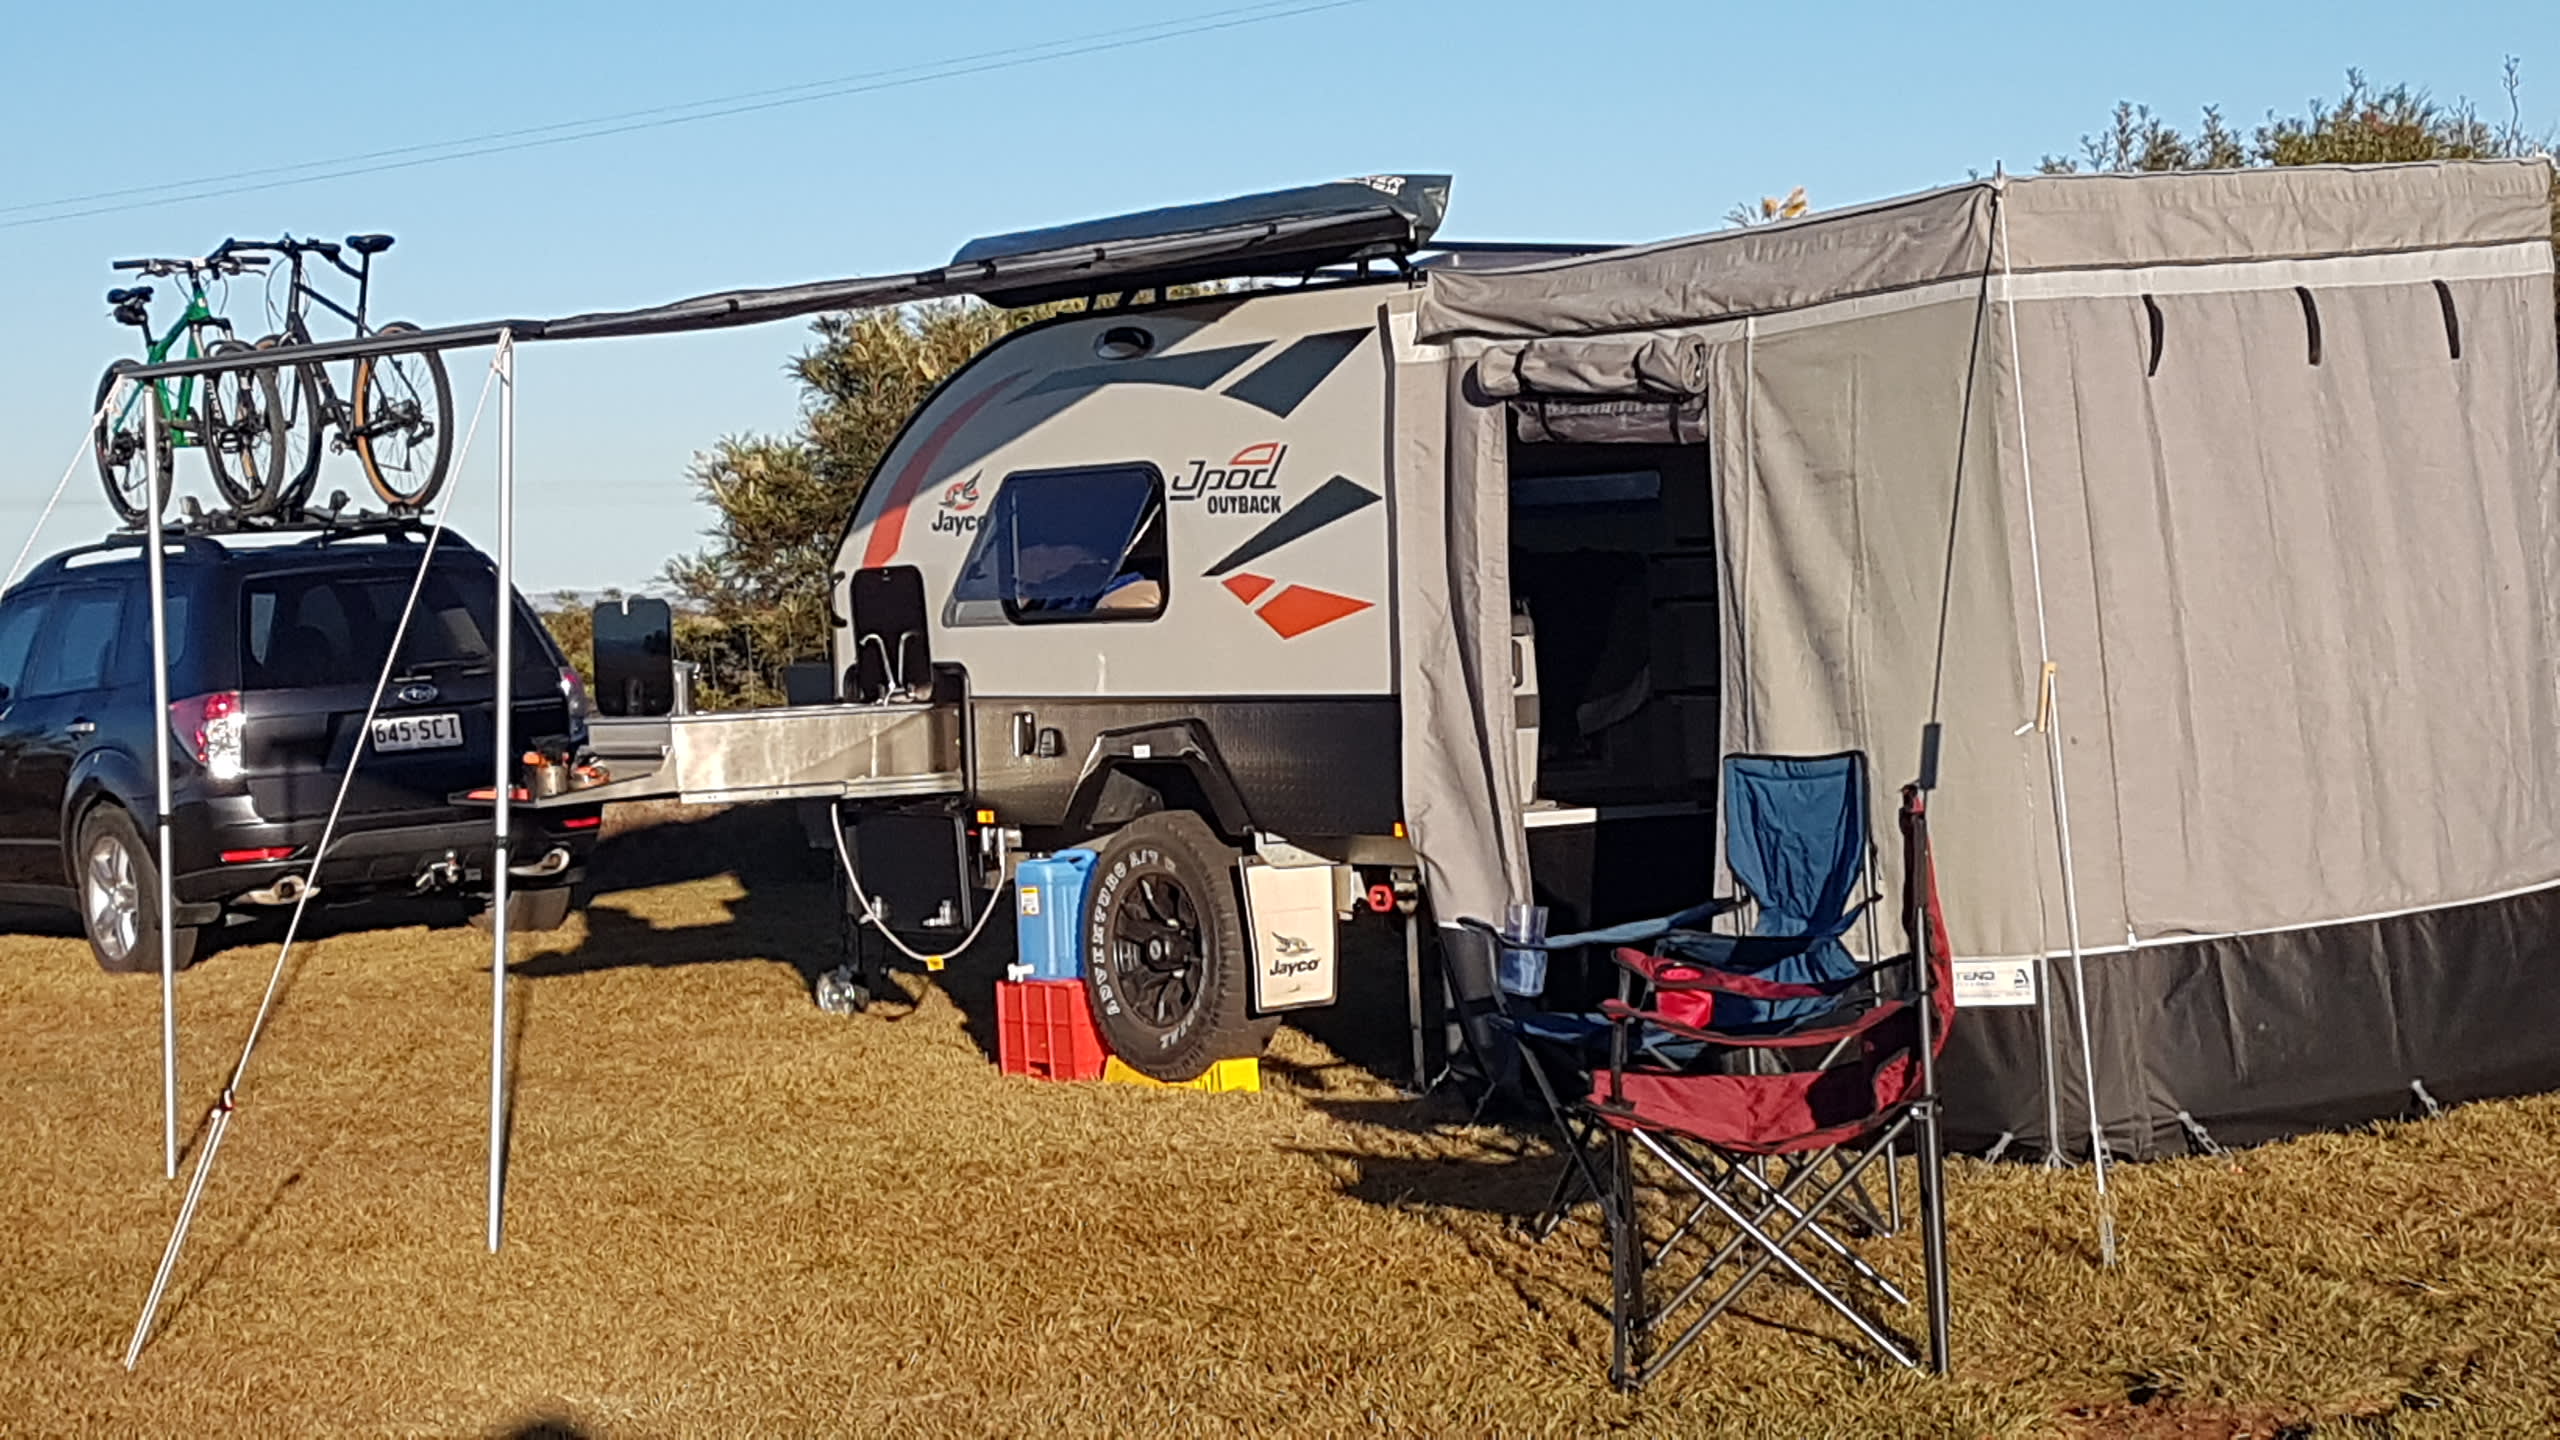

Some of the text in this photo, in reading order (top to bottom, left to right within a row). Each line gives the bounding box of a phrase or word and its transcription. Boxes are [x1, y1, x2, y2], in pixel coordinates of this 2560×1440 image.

[1171, 442, 1288, 499] Jpod
[1207, 495, 1281, 514] OUTBACK
[1269, 959, 1320, 977] Jayco
